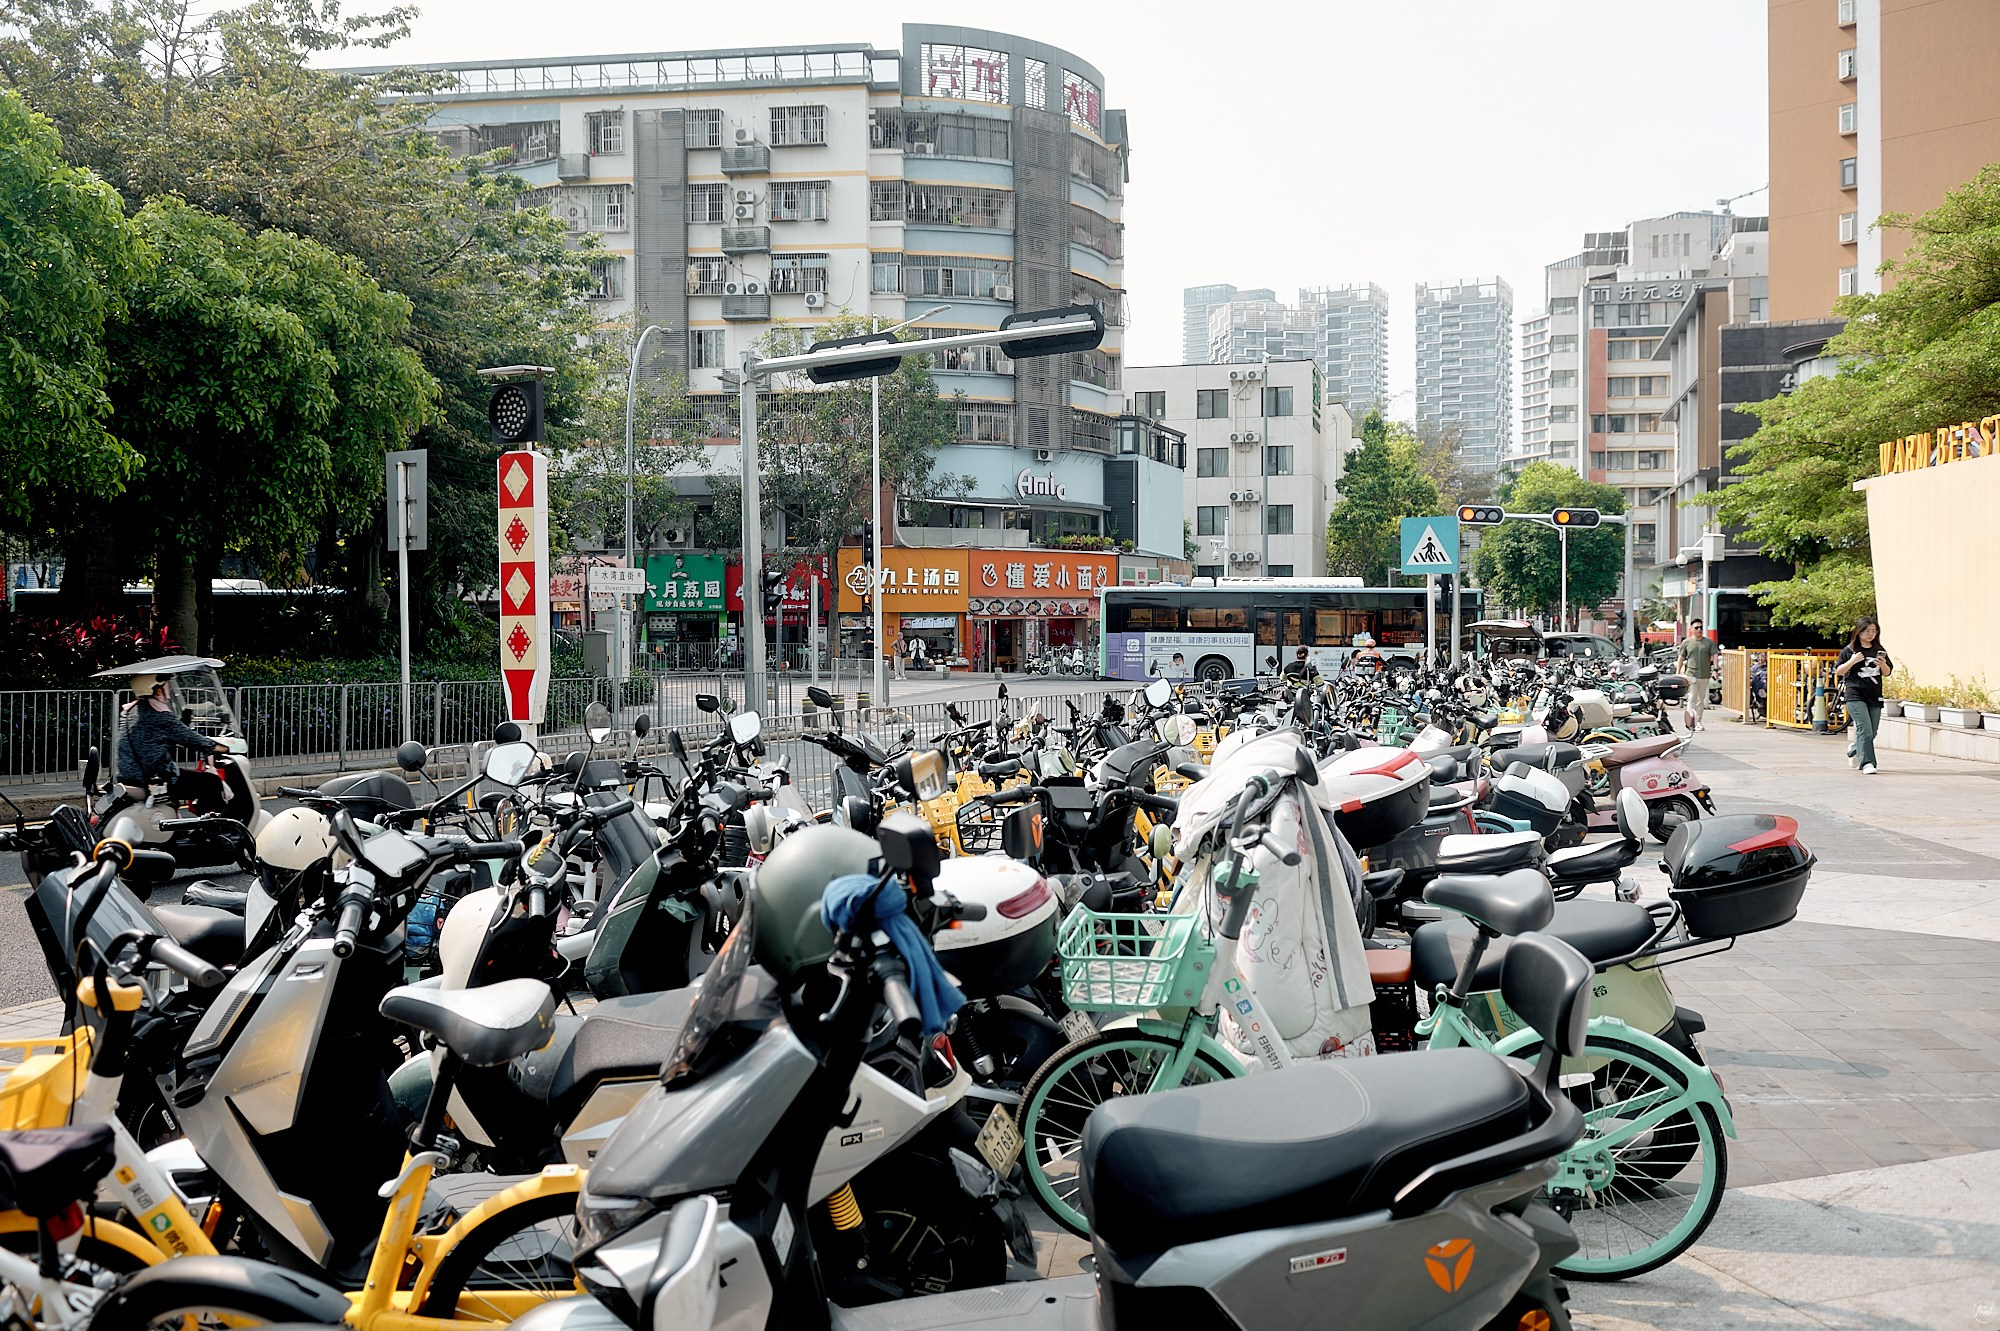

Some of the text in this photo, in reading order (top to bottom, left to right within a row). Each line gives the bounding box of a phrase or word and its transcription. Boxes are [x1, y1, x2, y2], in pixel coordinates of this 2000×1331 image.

[1879, 432, 1931, 476] WARM
[601, 570, 634, 581] 水湾直街
[880, 567, 959, 586] 九上汤包
[1006, 562, 1092, 591] 懂爱小面
[646, 580, 720, 599] 六月荔园
[842, 1133, 862, 1146] FX
[128, 1182, 154, 1210] 美团
